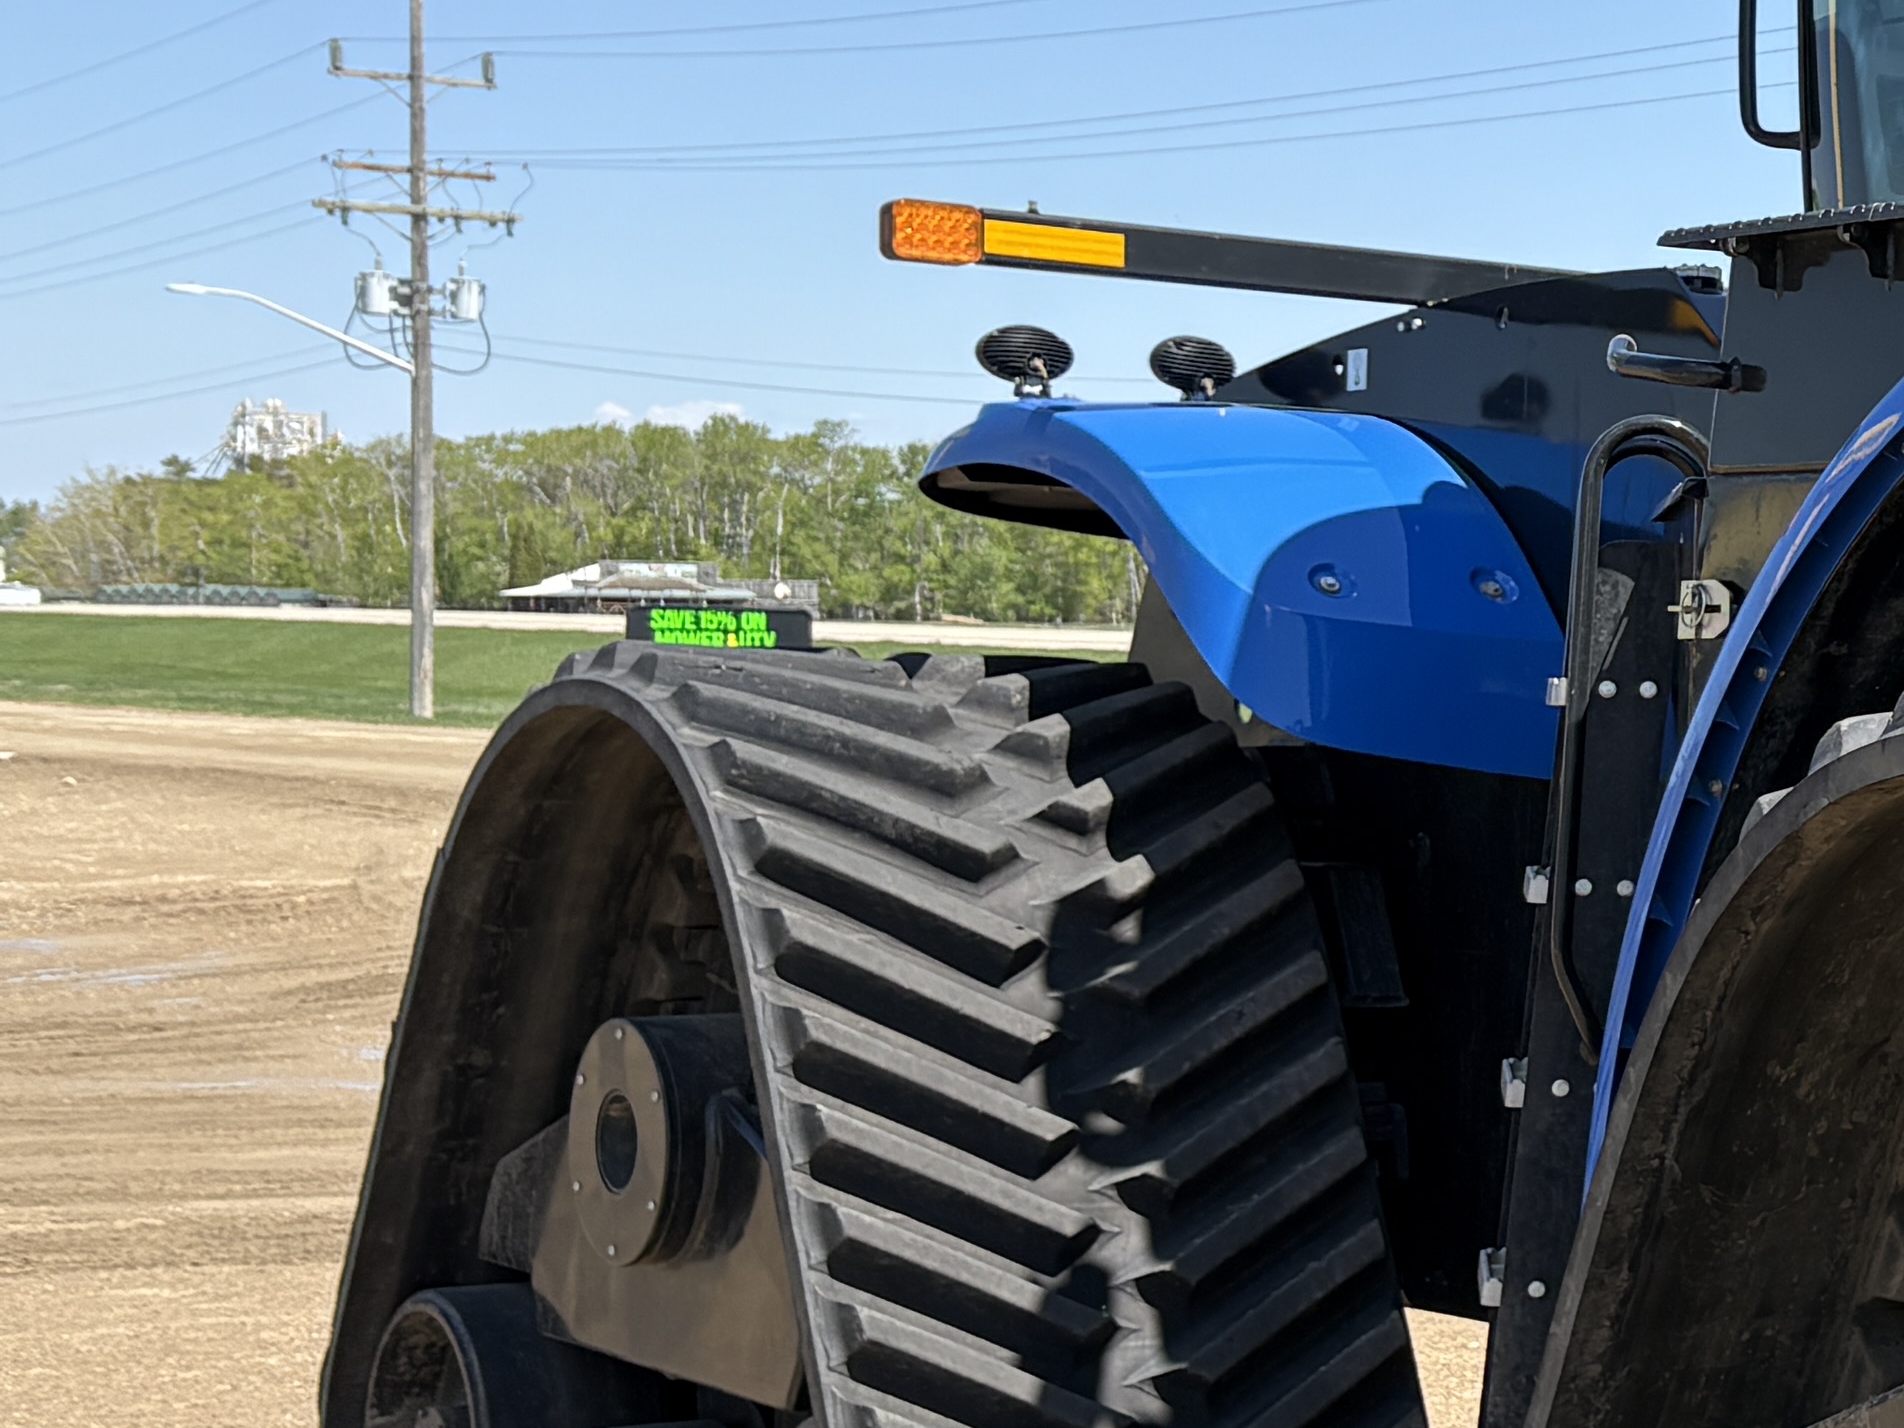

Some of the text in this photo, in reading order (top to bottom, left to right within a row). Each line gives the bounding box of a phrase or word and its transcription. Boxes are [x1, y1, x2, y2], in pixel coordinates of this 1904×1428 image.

[650, 609, 767, 631] SAVE 15% ON
